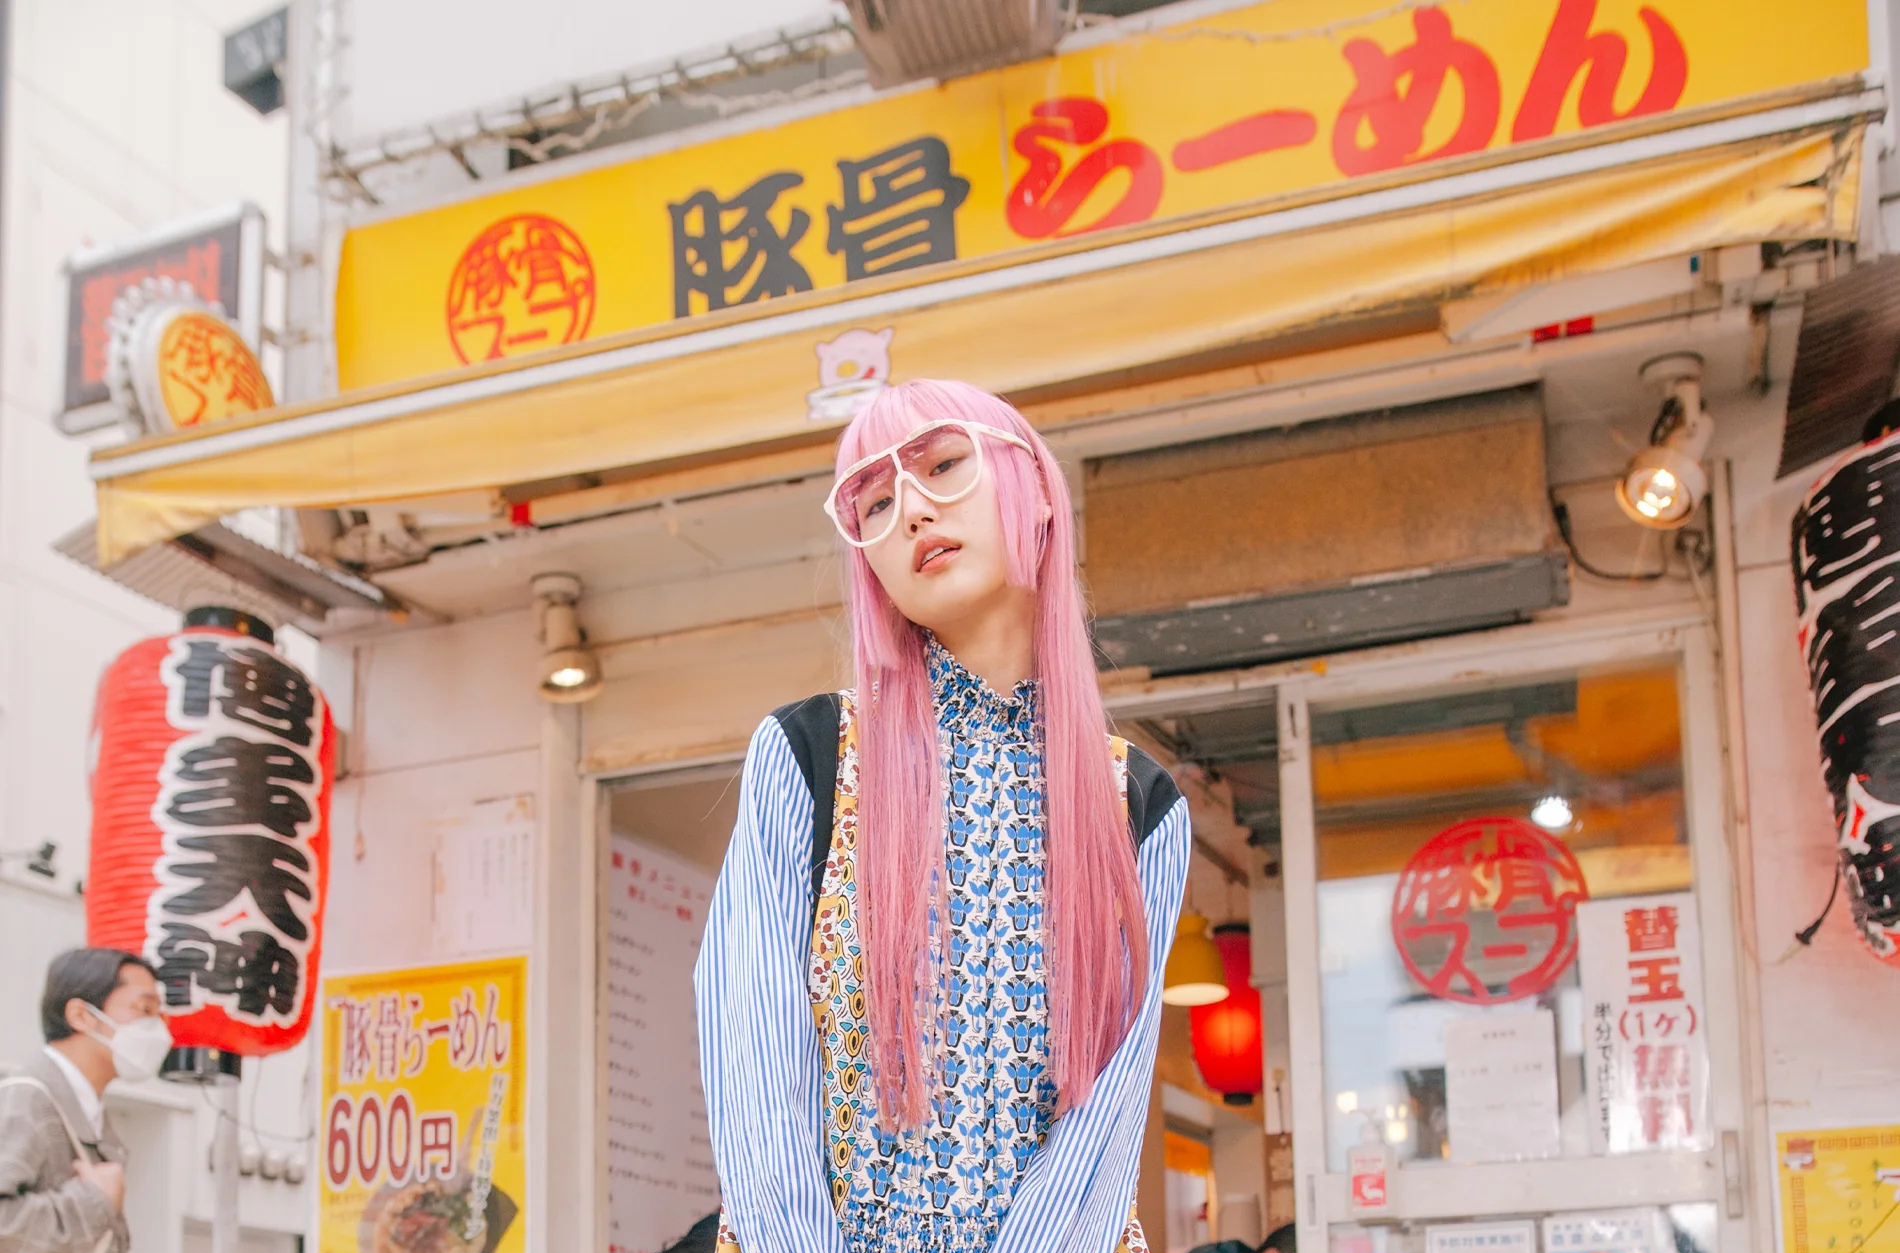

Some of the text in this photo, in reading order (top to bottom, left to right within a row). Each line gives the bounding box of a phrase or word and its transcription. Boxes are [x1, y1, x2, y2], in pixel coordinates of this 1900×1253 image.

[338, 985, 508, 1080] 豚骨らーめん
[328, 1094, 453, 1185] 600円
